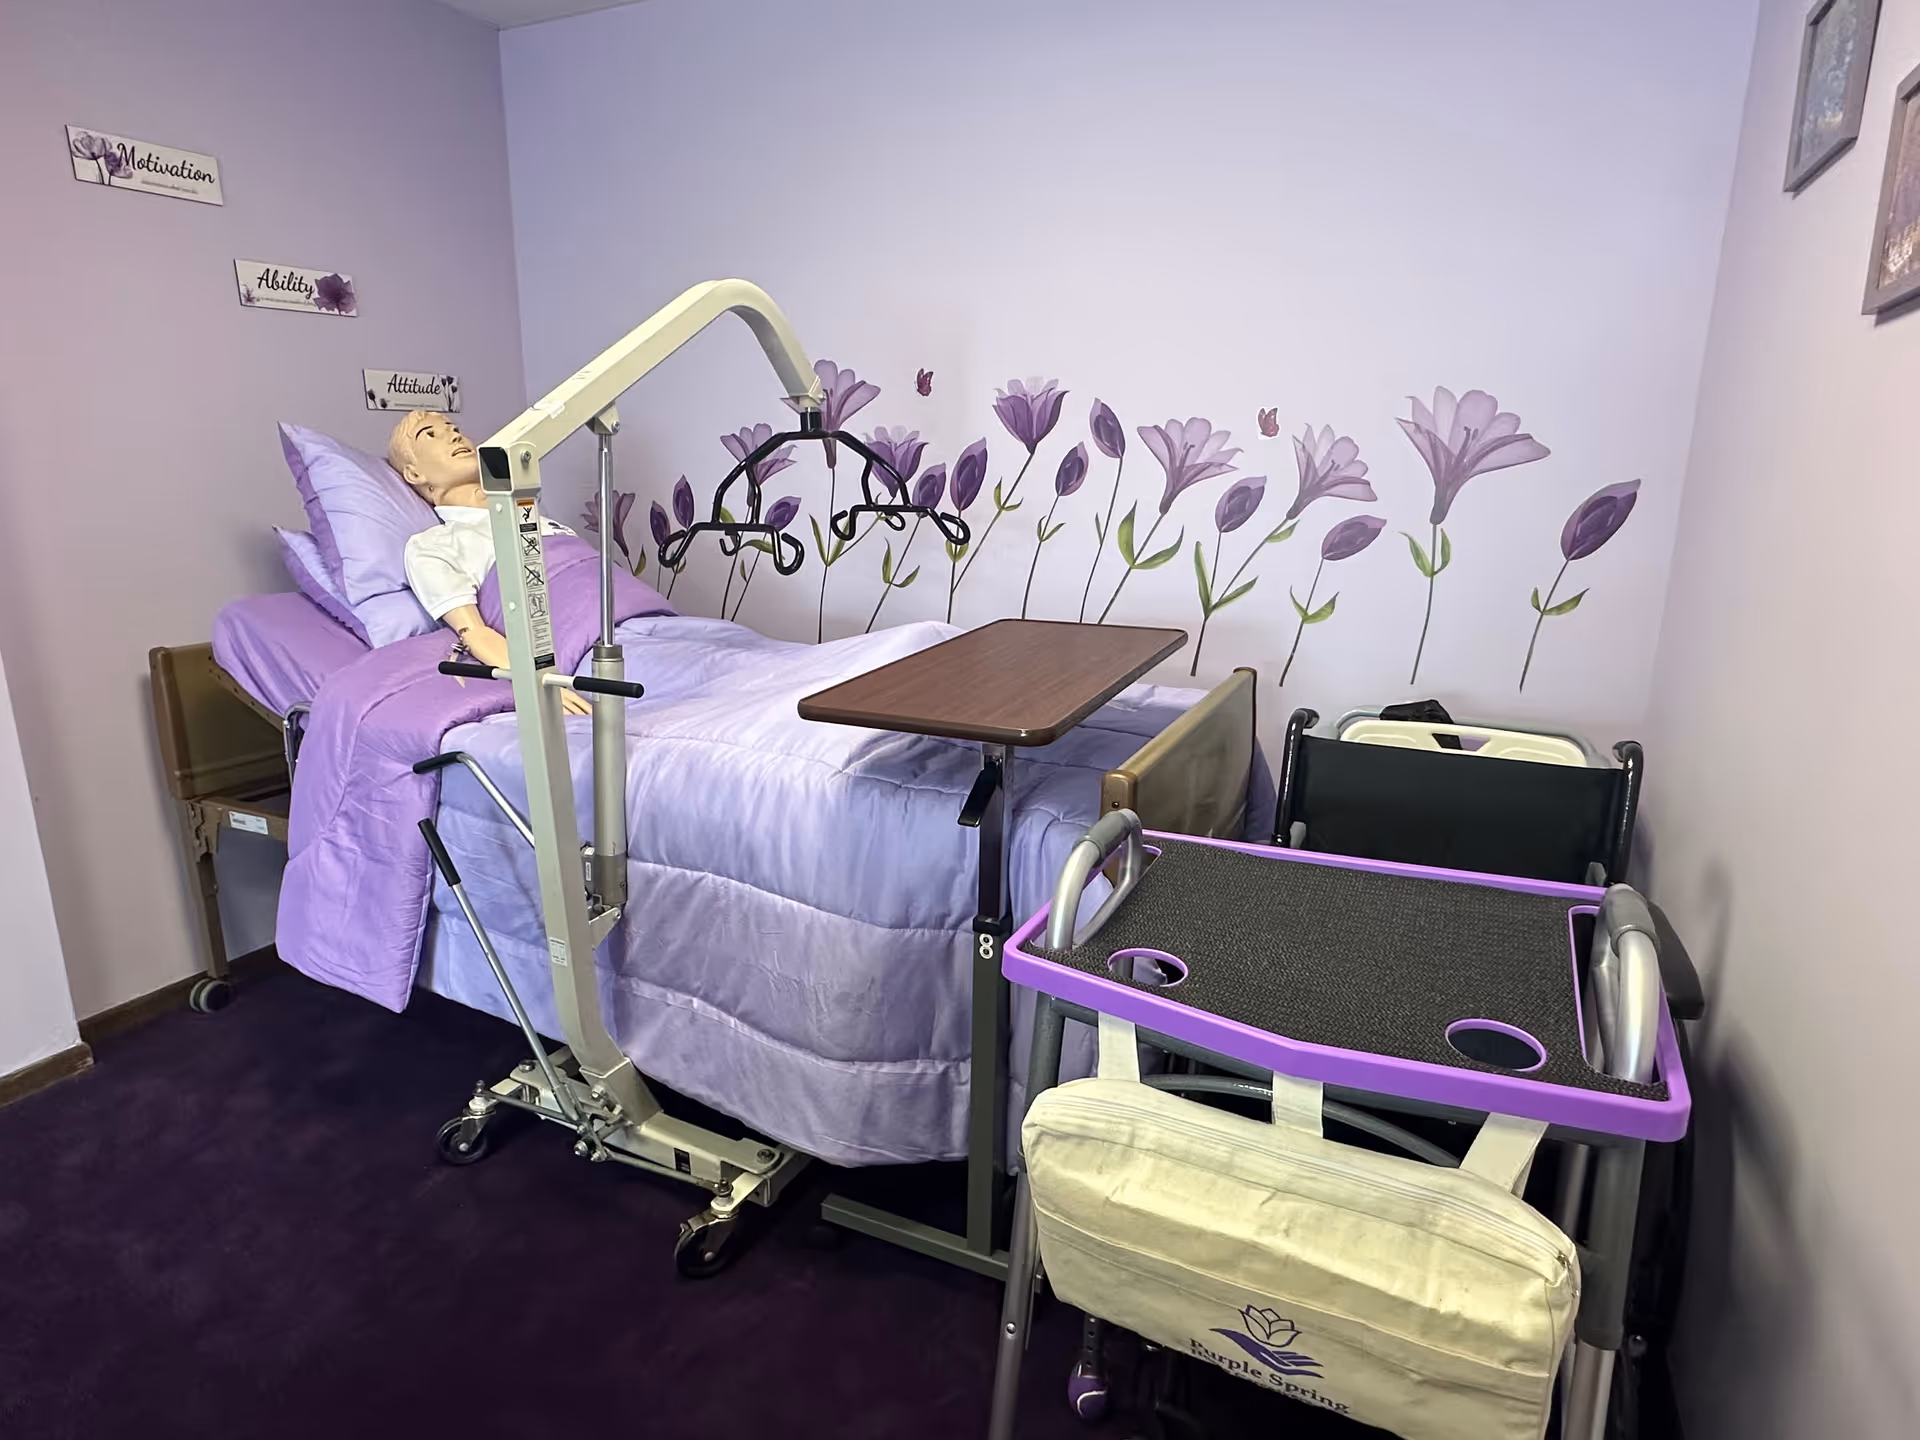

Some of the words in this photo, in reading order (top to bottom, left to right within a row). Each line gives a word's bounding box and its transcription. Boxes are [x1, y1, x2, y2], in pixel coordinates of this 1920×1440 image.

[117, 142, 215, 184] Motivation
[257, 268, 315, 299] Ability
[387, 373, 442, 395] Attitude
[1189, 1338, 1262, 1378] Purple
[1269, 1373, 1351, 1415] Spring
